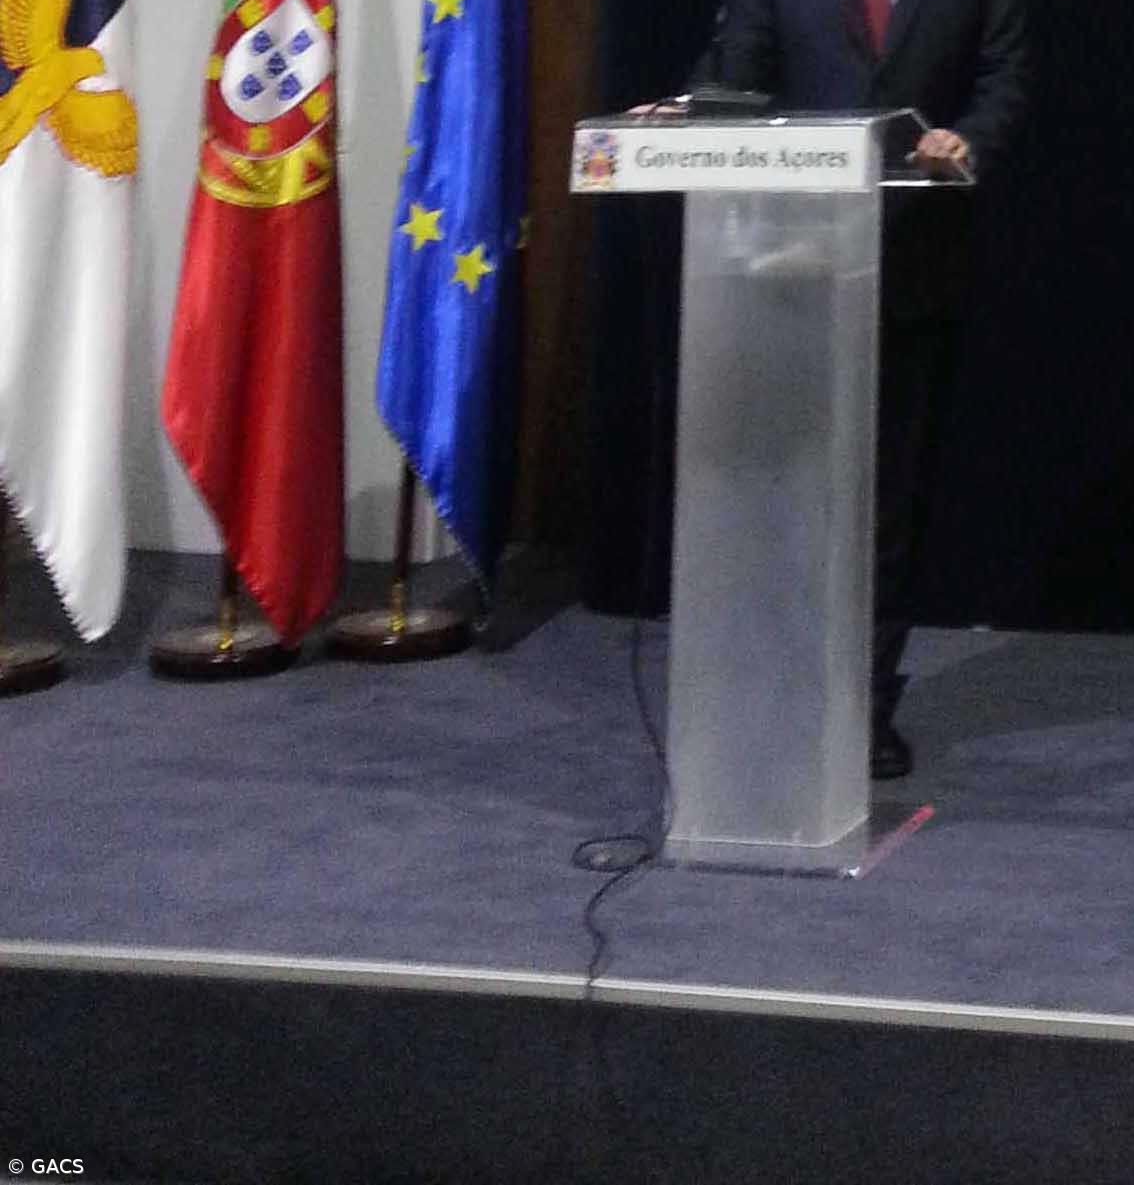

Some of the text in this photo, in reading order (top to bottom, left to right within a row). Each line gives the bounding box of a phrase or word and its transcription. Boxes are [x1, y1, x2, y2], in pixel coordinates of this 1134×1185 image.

[635, 145, 850, 172] Governo dos Açores
